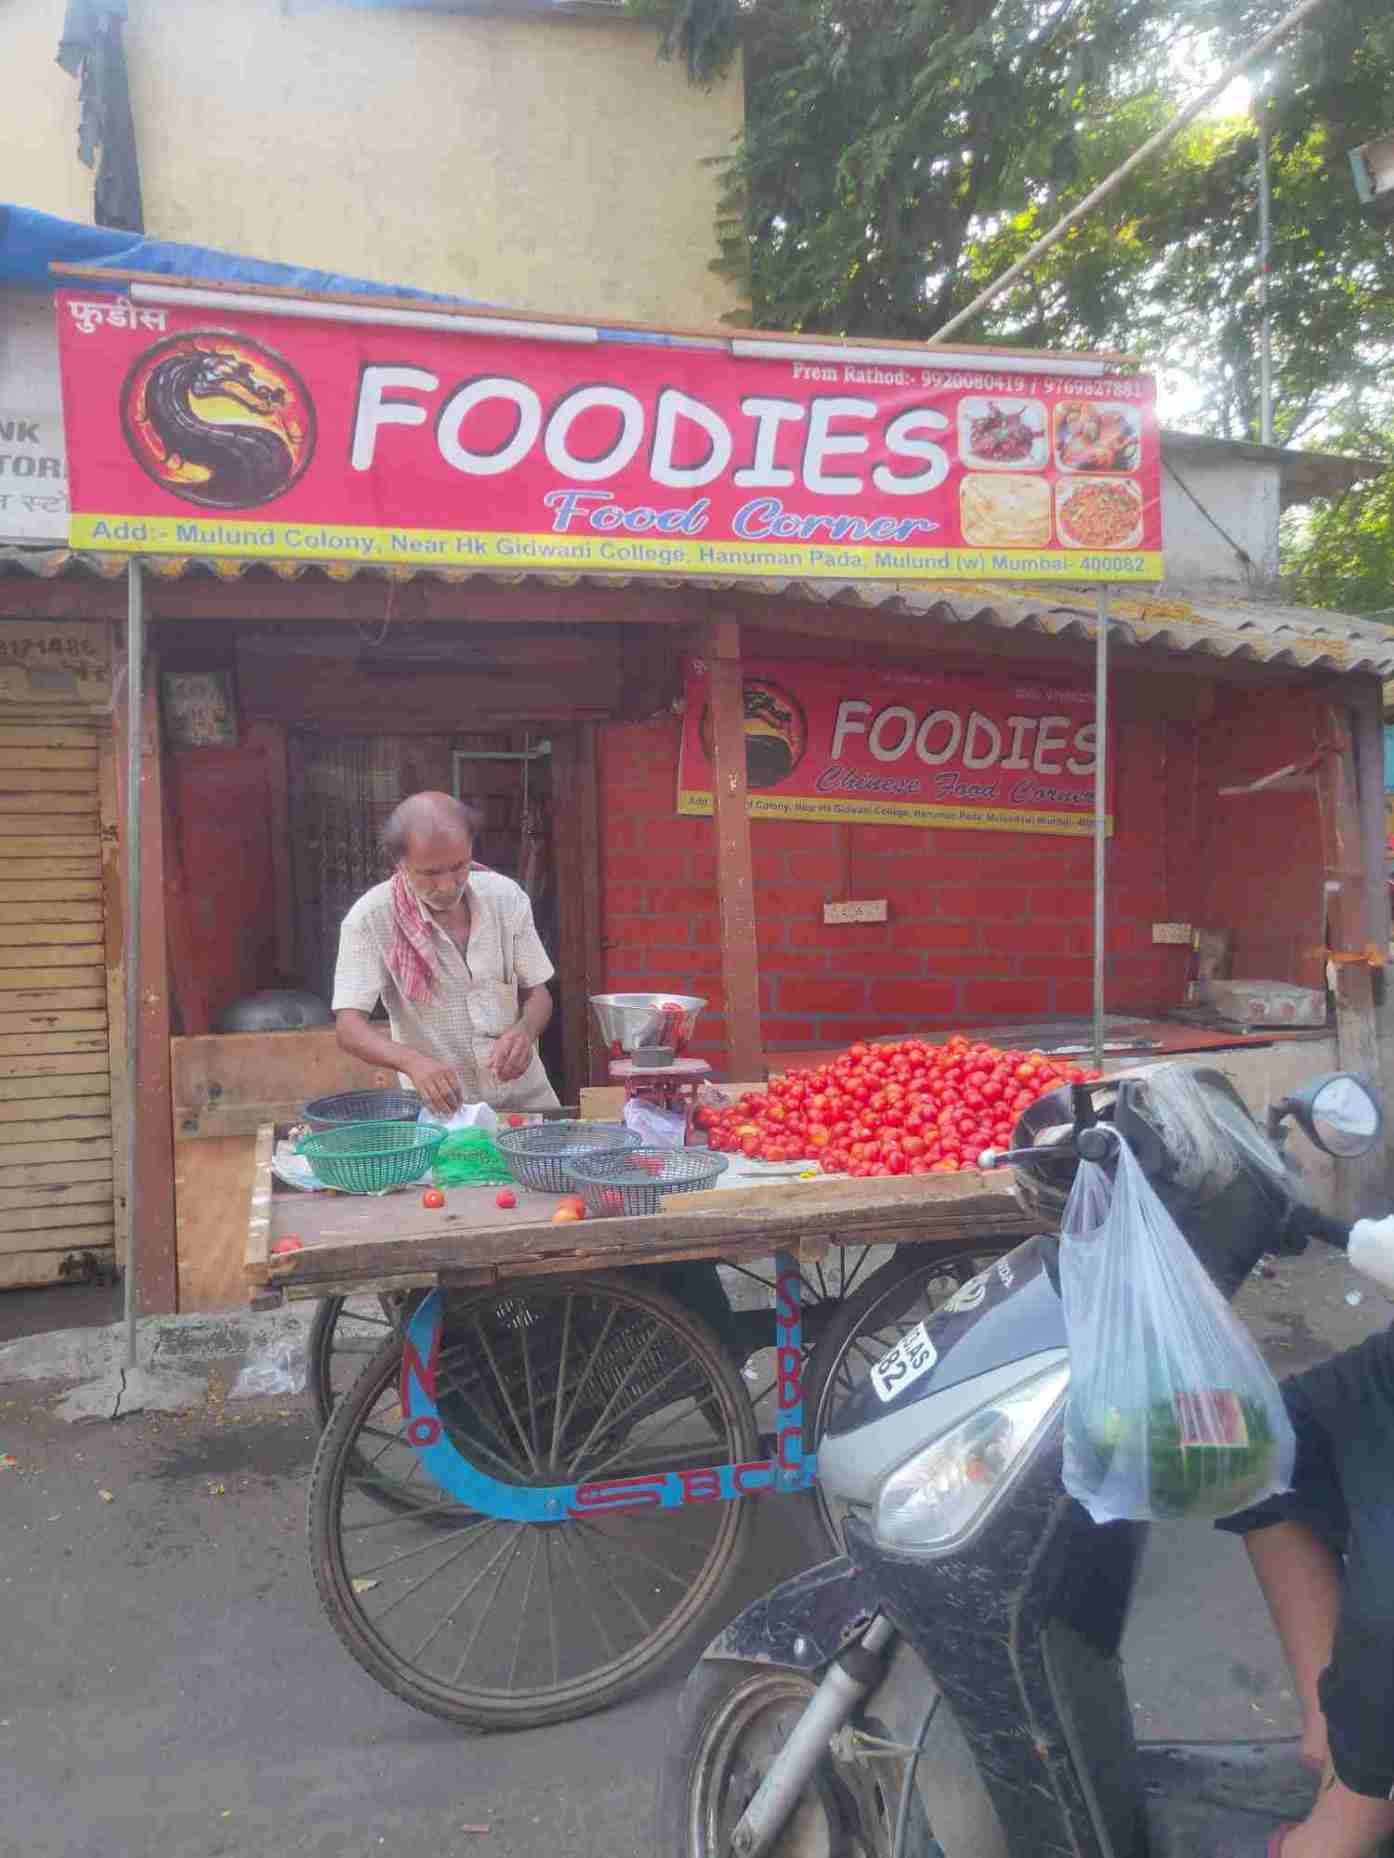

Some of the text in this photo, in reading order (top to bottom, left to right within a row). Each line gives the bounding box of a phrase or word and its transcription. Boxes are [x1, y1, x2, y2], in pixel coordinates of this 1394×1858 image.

[792, 364, 837, 382] Prem
[350, 363, 951, 496] FOODIES
[543, 489, 940, 541] Food Corner
[176, 524, 275, 546] Mulund
[391, 534, 448, 553] Near
[456, 536, 485, 555] Hk
[496, 538, 592, 560] Gidwani
[699, 546, 803, 567] Hanuman
[874, 551, 949, 571] Mulund
[830, 698, 1098, 775] FOODIES
